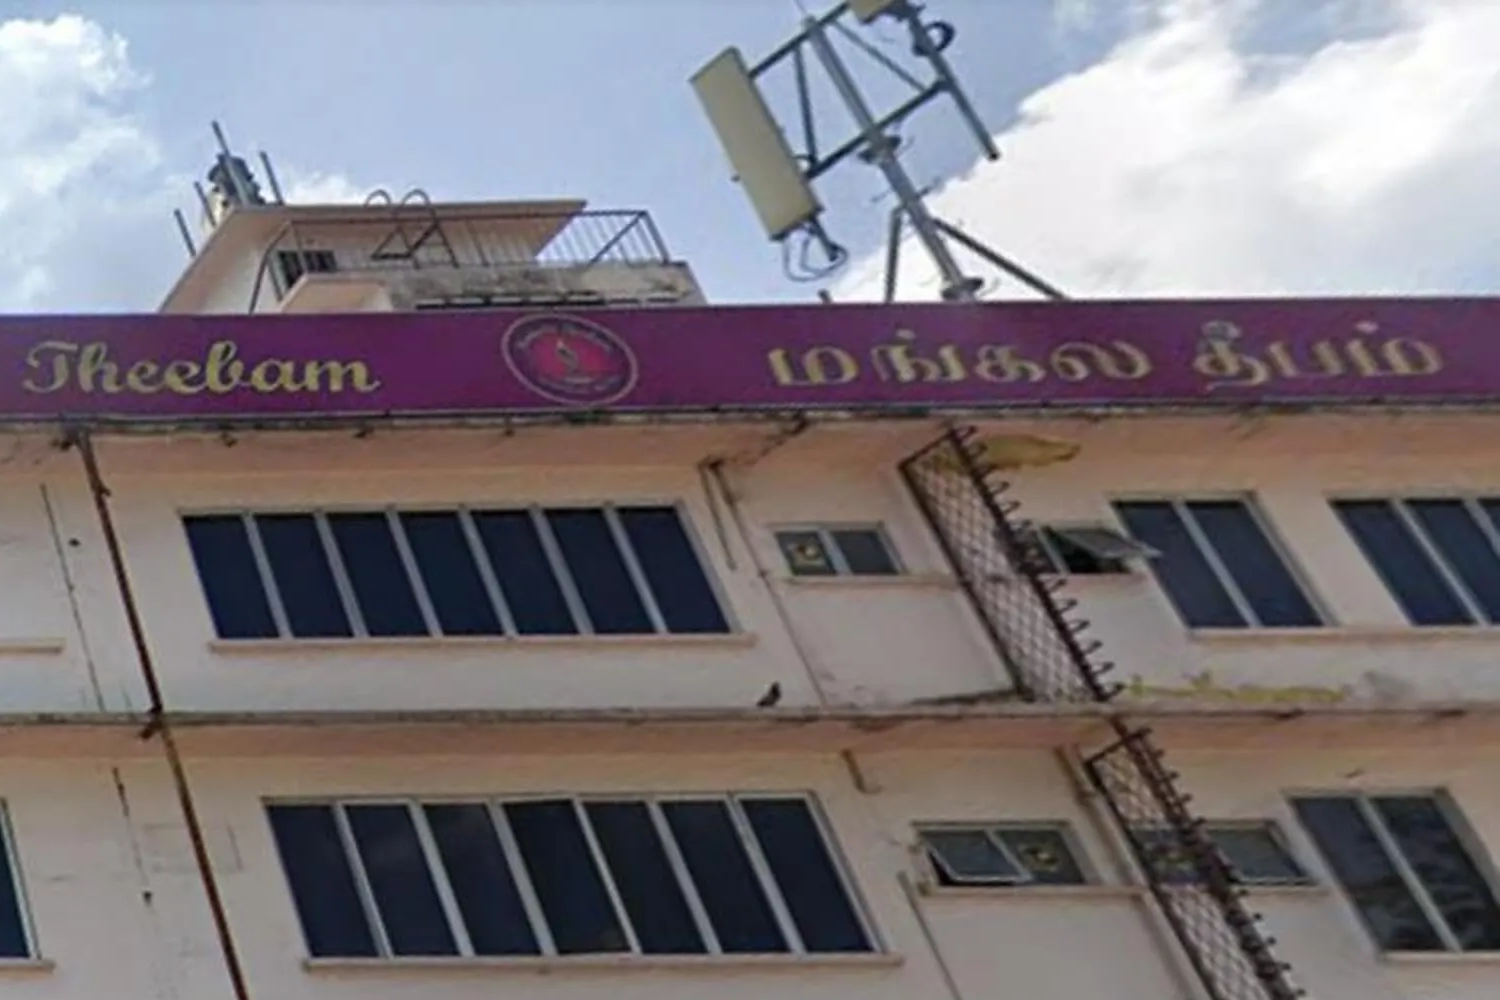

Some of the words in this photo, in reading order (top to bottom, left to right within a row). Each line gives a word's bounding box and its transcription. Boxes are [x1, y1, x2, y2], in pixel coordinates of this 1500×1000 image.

[23, 339, 380, 394] Theebam
[768, 329, 1153, 386] மங்கல
[1193, 321, 1443, 392] தீபம்
